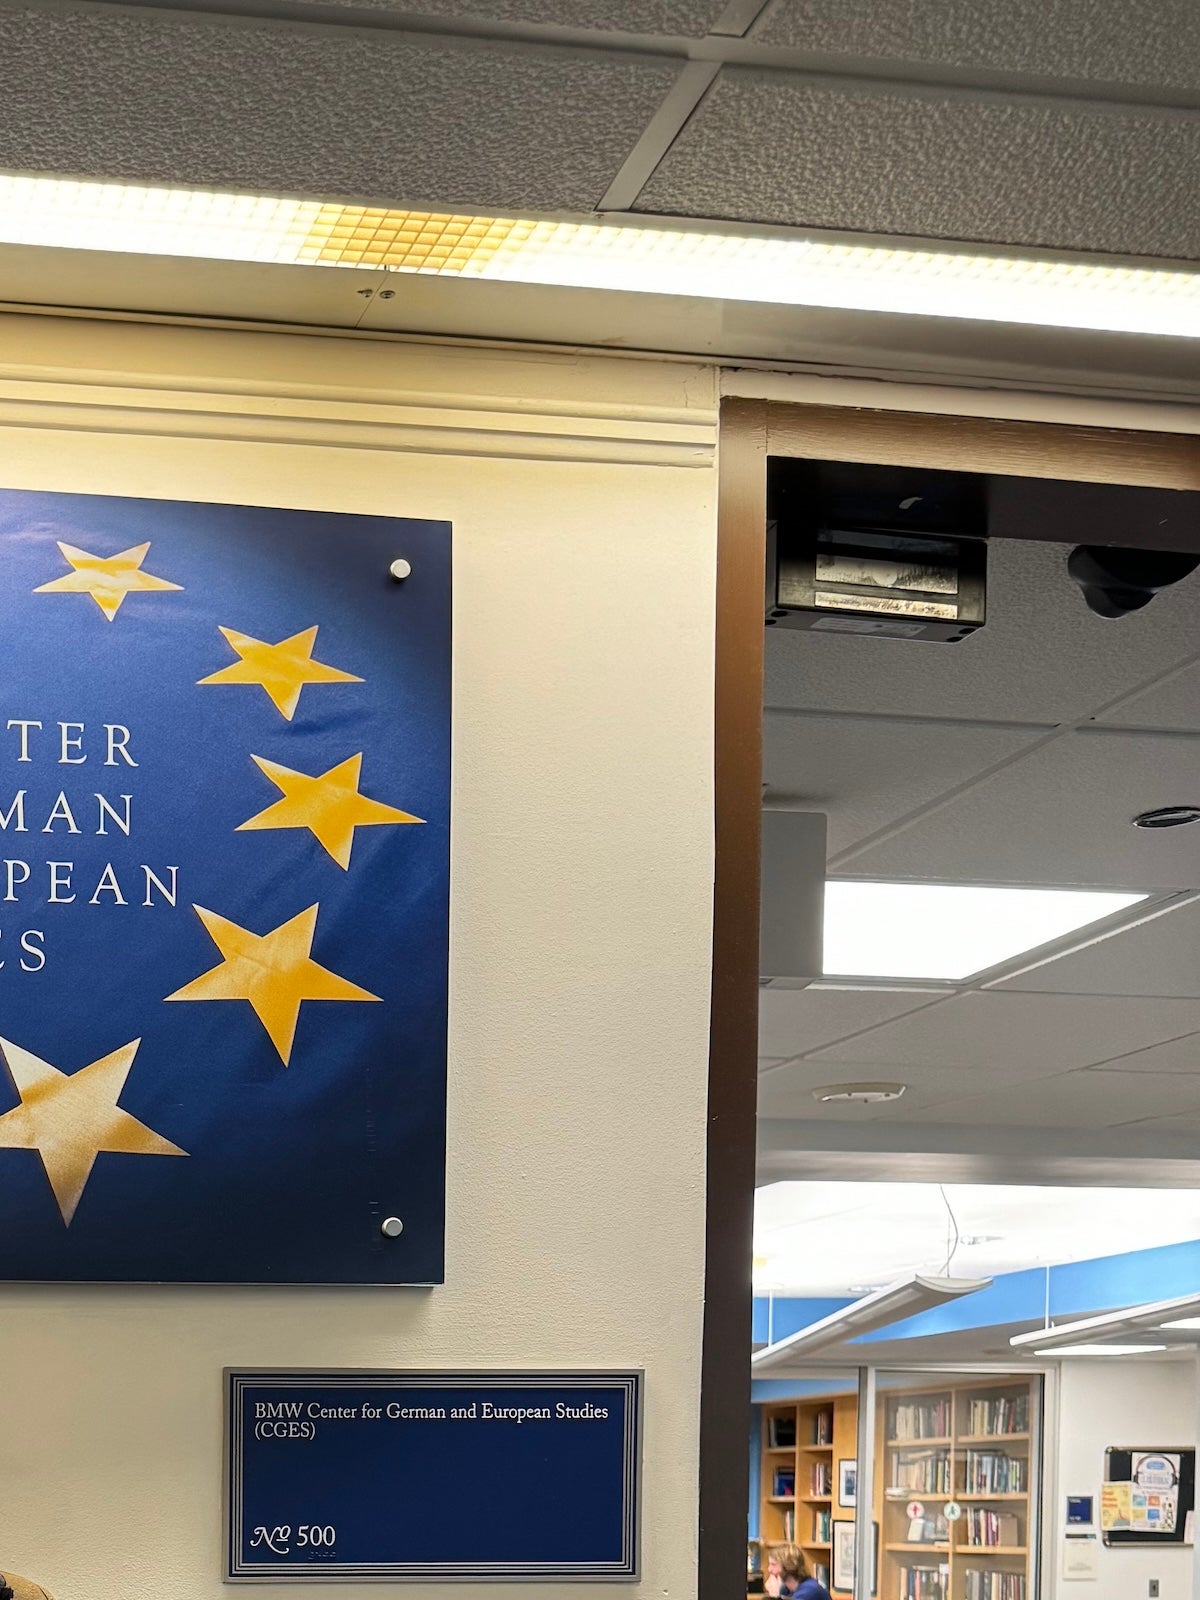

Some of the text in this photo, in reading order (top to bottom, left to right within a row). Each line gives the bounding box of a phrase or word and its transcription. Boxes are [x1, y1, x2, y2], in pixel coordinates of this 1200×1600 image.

[254, 1402, 609, 1424] BMW Center for German and European Studies
[254, 1421, 316, 1441] (CGES)
[296, 1525, 336, 1546] 500
